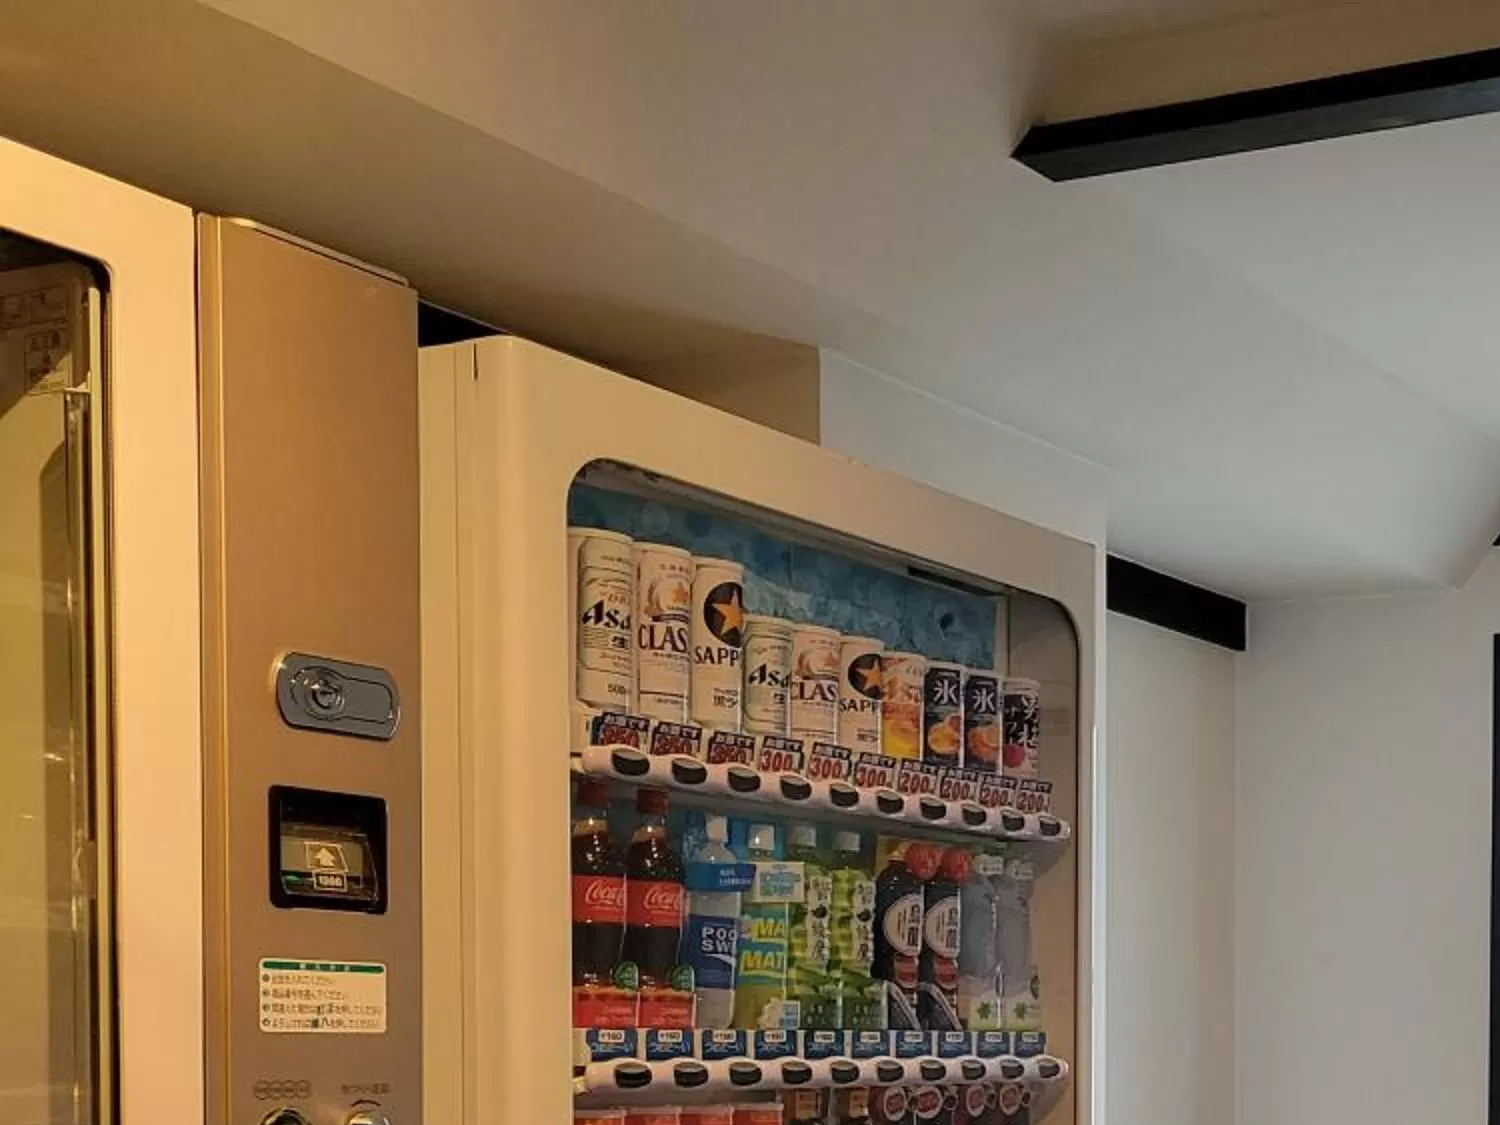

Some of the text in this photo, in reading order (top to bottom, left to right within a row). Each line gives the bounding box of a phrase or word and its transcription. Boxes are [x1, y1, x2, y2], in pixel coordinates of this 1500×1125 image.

[695, 647, 738, 666] SAPP
[933, 679, 958, 705] 氷
[972, 687, 995, 713] 氷
[761, 750, 793, 772] 300
[810, 758, 842, 779] 300
[858, 766, 886, 788] 300
[902, 773, 930, 794] 200
[942, 779, 970, 800] 200
